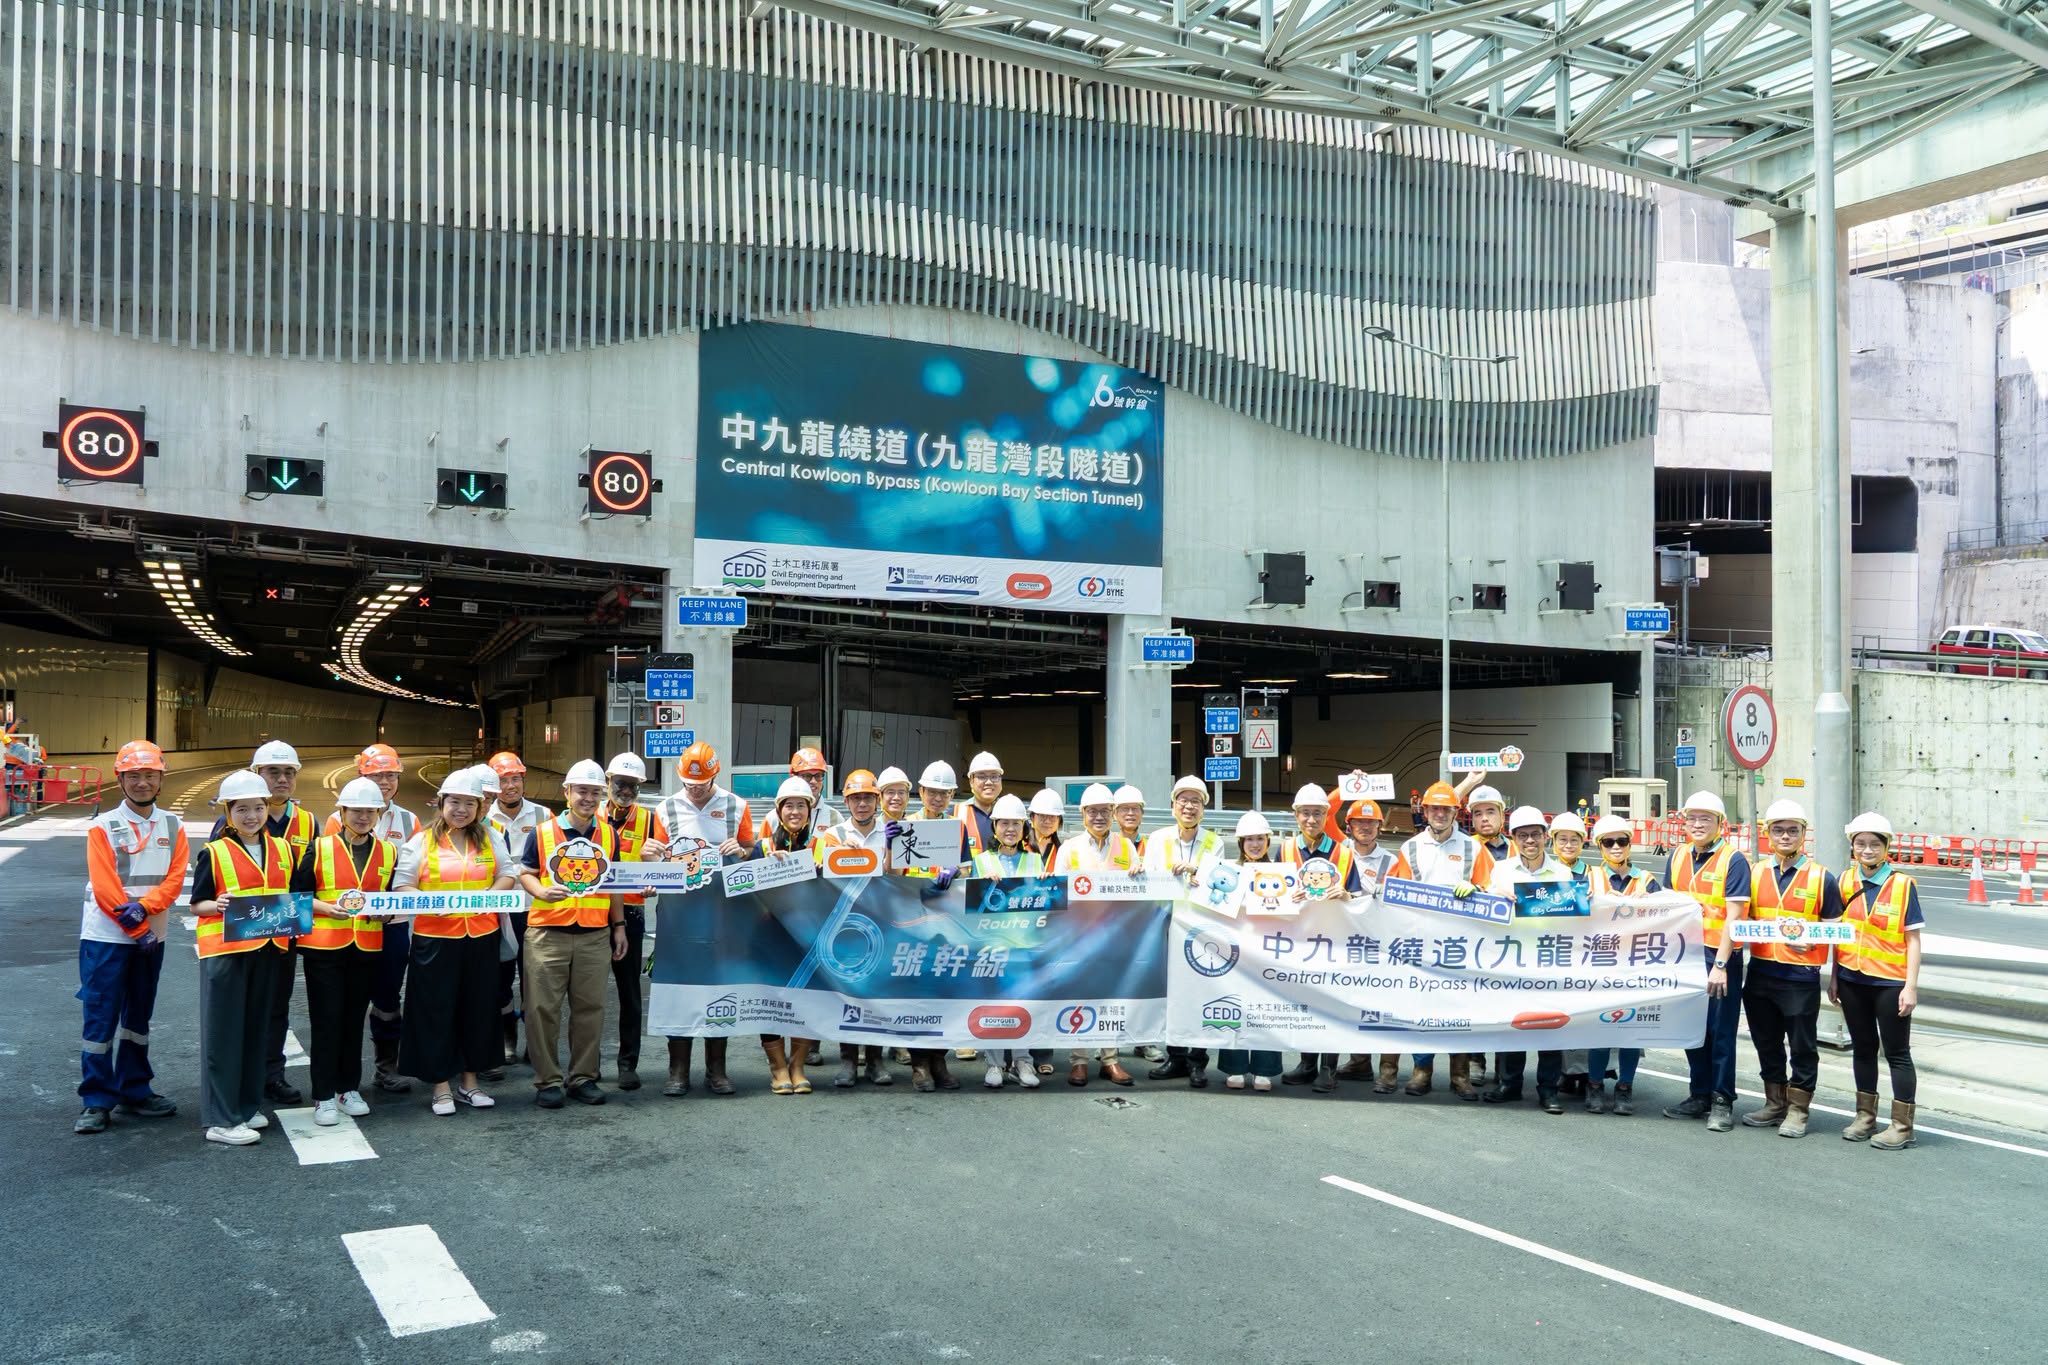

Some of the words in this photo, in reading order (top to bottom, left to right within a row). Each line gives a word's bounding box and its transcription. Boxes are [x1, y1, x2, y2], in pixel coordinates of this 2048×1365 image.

[78, 430, 125, 457] 80
[721, 412, 1144, 486] 中九龍繞道(九龍灣段隧道)
[604, 472, 638, 494] 80
[721, 457, 785, 477] Central
[790, 464, 861, 485] Kowloon
[866, 471, 921, 490] Bypass
[925, 476, 998, 497] (Kowloon
[1002, 484, 1030, 502] Bay
[1034, 486, 1088, 503] Section
[1092, 490, 1144, 511] Tunnel)
[723, 562, 766, 578] CEDD
[771, 558, 839, 572] 土木工程拓展署
[771, 570, 787, 579] Civil
[787, 571, 829, 582] Engineering
[771, 579, 816, 589] Development
[817, 581, 856, 591] Department
[1106, 588, 1124, 597] BYME
[681, 600, 705, 608] KEEP
[707, 601, 717, 609] IN
[719, 601, 743, 609] LANE
[662, 679, 679, 688] 留意
[1745, 702, 1757, 727] 8
[1736, 731, 1769, 747] km/h
[1451, 755, 1498, 768] 利民便民
[758, 874, 787, 885] Development
[787, 868, 813, 879] Department
[767, 866, 794, 878] Engineering
[726, 872, 754, 887] CEDD
[370, 894, 521, 911] 中九龍繞道(九龍灣段)
[1007, 896, 1046, 910] 號幹線
[1530, 906, 1545, 914] City
[977, 918, 1030, 930] Route
[1036, 915, 1048, 928] 6
[244, 929, 273, 938] Minutes
[274, 926, 292, 934] Away
[1734, 924, 1777, 937] 惠民生
[1808, 925, 1852, 939] 添幸福
[1262, 931, 1687, 970] 中九龍繞道(九龍灣段)
[890, 942, 1012, 978] 號幹線
[1262, 968, 1327, 985] Central
[1331, 972, 1403, 989] Kowloon
[1409, 976, 1468, 992] Bypass
[1474, 976, 1558, 992] (Kowloon
[1563, 976, 1599, 992] Bay
[1602, 973, 1679, 990] Section)
[706, 1005, 737, 1018] CEDD
[751, 1008, 783, 1017] Engineering
[1202, 1007, 1242, 1021] CEDD
[1246, 1013, 1261, 1021] Civil
[1262, 1014, 1299, 1023] Engineering
[1636, 1013, 1661, 1022] BYME
[739, 1016, 772, 1024] Development
[772, 1017, 805, 1026] Department
[893, 1015, 943, 1025] MEINHARDT
[1098, 1020, 1126, 1032] BYME
[1246, 1021, 1288, 1030] Development
[1289, 1022, 1326, 1031] Department
[1417, 1017, 1472, 1028] MEINHARDT
